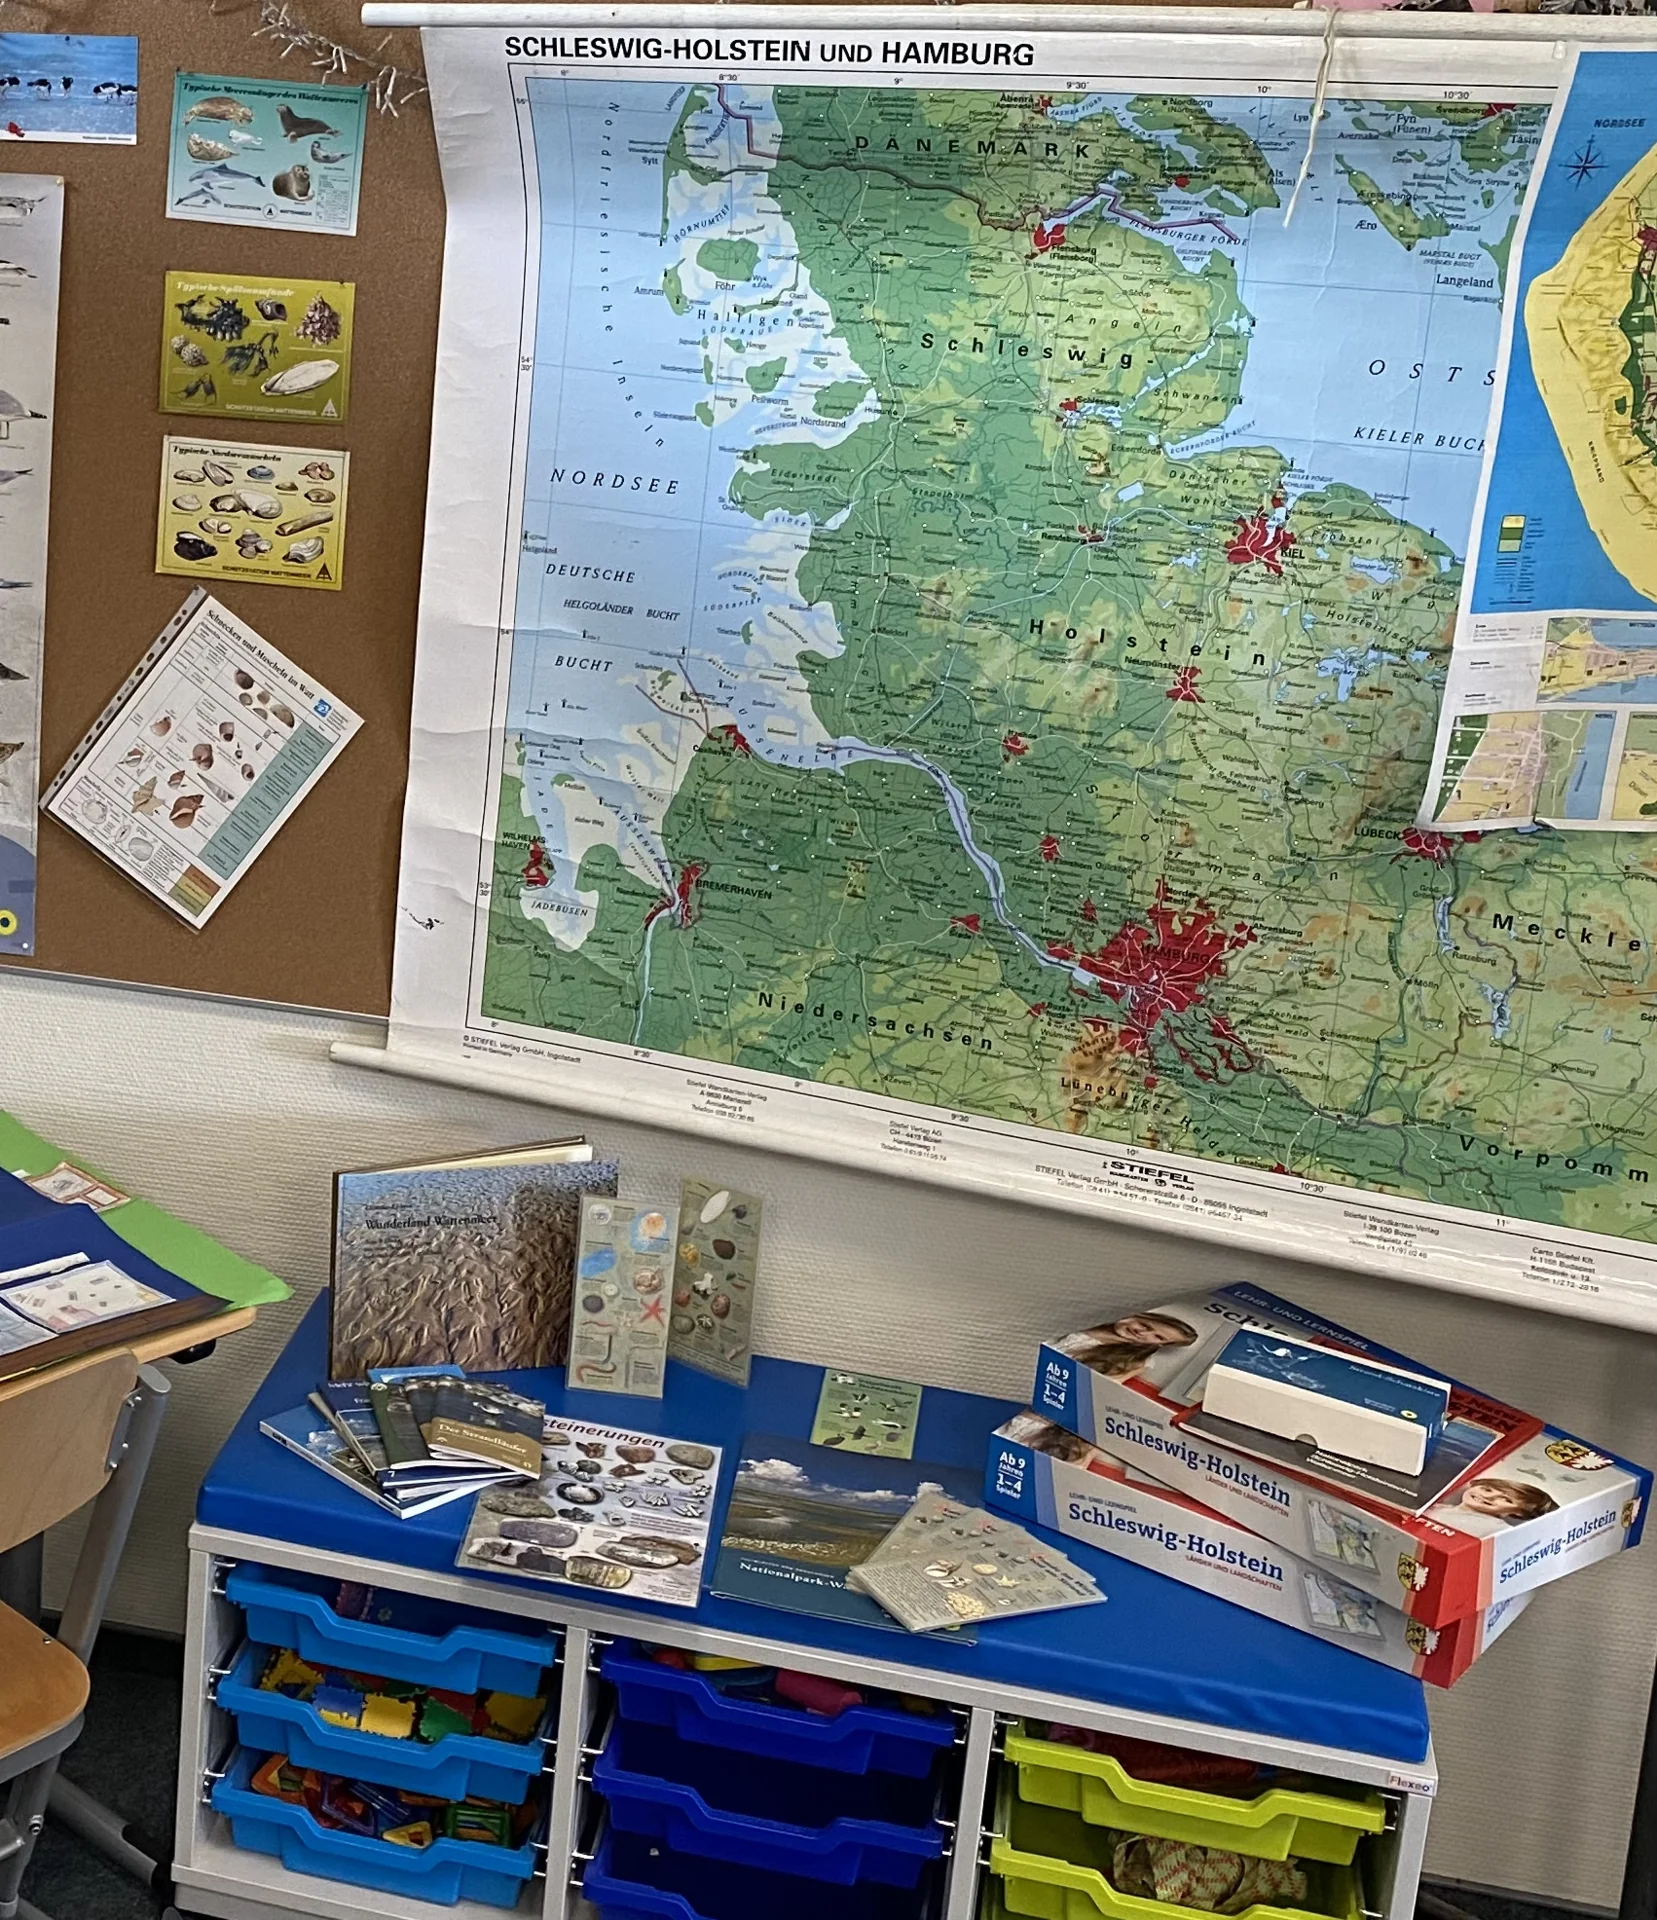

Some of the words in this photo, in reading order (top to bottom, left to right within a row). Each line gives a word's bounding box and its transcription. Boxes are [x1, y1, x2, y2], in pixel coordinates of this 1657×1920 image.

[505, 36, 810, 62] SCHLESWIG-HOLSTEIN
[820, 44, 873, 62] UND
[882, 41, 1035, 66] HAMBURG
[1593, 118, 1647, 128] NORDSEE
[855, 132, 1090, 159] DÄNEMARK
[641, 156, 659, 166] Sylt
[1129, 219, 1206, 244] FLENSBURGER
[715, 281, 736, 291] Föhr
[1436, 273, 1495, 289] Langeland
[697, 308, 794, 327] Halligen
[800, 416, 847, 429] Nordstrand
[1353, 426, 1425, 445] KIELER
[549, 467, 679, 495] NORDSEE
[1280, 547, 1306, 560] KIEL
[545, 562, 636, 584] DEUTSCHE
[563, 598, 634, 616] HELGOLÄNDER
[646, 608, 681, 622] BUCHT
[1029, 618, 1266, 667] Holstein
[205, 608, 243, 642] Schnecken
[255, 649, 289, 680] Muscheln
[298, 683, 316, 700] Watt
[554, 654, 614, 673] BUCHT
[1124, 655, 1183, 671] Neumünster
[502, 831, 546, 844] WILHELMS
[1354, 825, 1401, 841] LÜBECK
[501, 840, 531, 851] HAVEN
[695, 878, 773, 900] BREMERHAVEN
[530, 899, 589, 918] JADEBUSEN
[1253, 923, 1303, 938] Ahrensburg
[1492, 912, 1641, 951] Meckle
[1452, 950, 1498, 967] Ratzeburg
[758, 991, 993, 1051] Niedersachsen
[1060, 1076, 1171, 1116] Lüneburger
[1110, 1161, 1196, 1185] STIEFEL
[365, 1215, 431, 1230] Wunderland
[1233, 1290, 1272, 1309] LEHR-
[1272, 1305, 1304, 1322] UND
[1302, 1318, 1369, 1352] LERNSPIEL
[1046, 1362, 1062, 1376] Ab
[1062, 1367, 1070, 1380] 9
[999, 1450, 1017, 1466] Ab
[1018, 1456, 1026, 1469] 9
[1105, 1416, 1291, 1507] Schleswig-Holstein
[1069, 1502, 1284, 1583] Schleswig-Holstein
[1499, 1508, 1617, 1585] Schleswig-Holstein
[739, 1561, 850, 1590] Nationalpark-W
[1389, 1774, 1431, 1793] Flexeo
